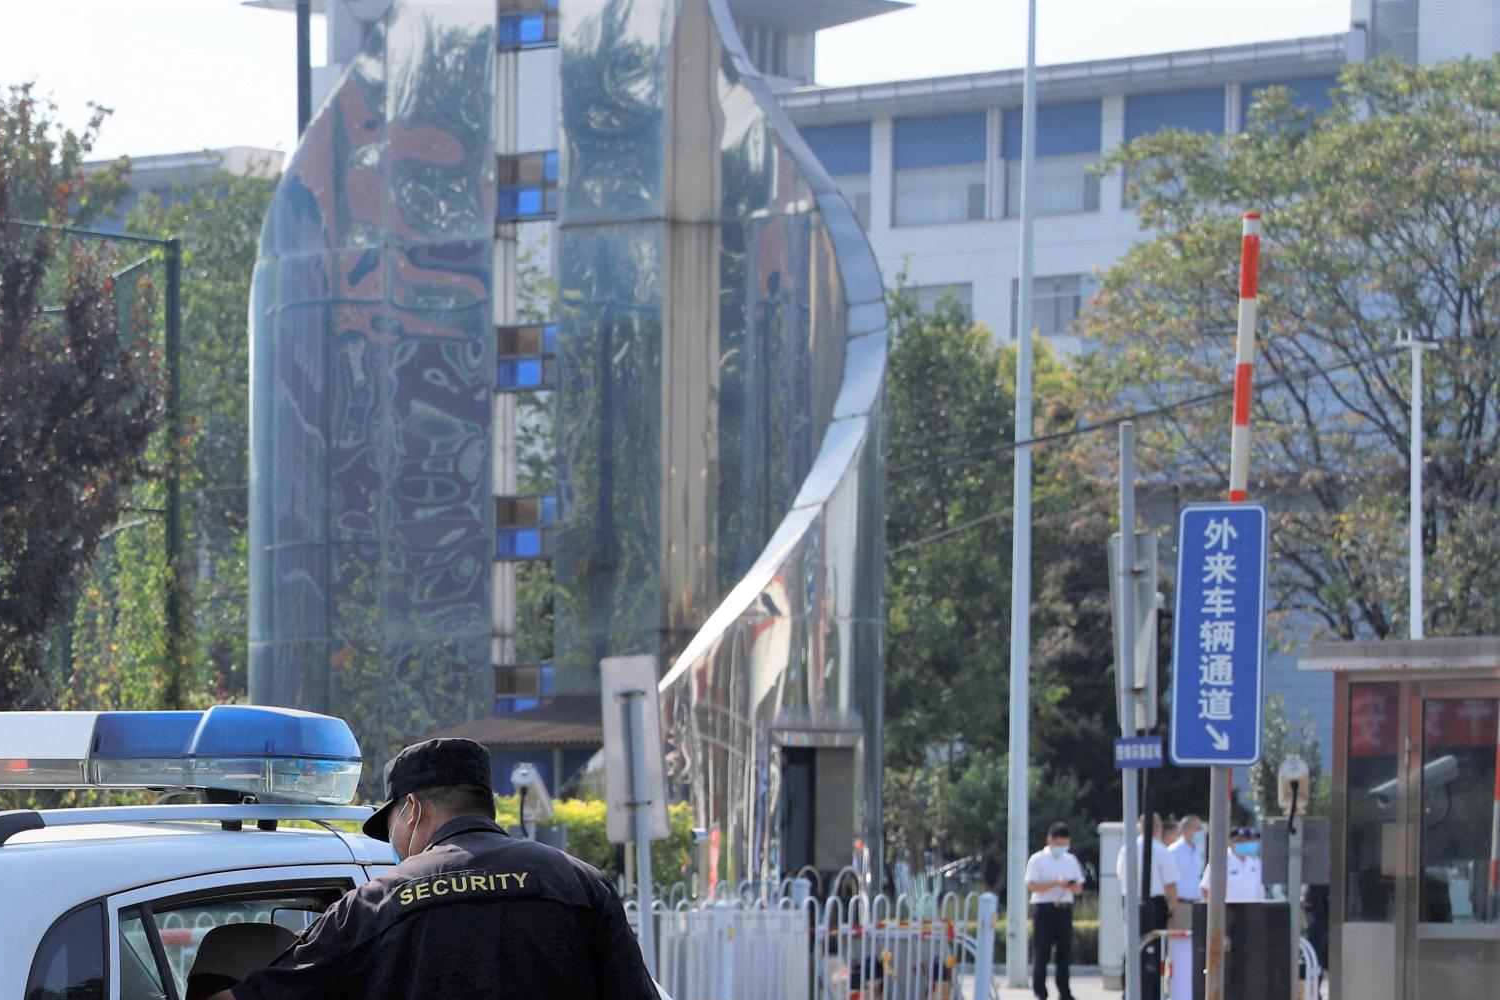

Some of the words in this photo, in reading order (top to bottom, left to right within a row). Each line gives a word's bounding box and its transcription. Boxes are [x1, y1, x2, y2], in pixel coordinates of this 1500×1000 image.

[1198, 517, 1237, 721] 外来车辆通道
[400, 872, 529, 906] SECURITY
